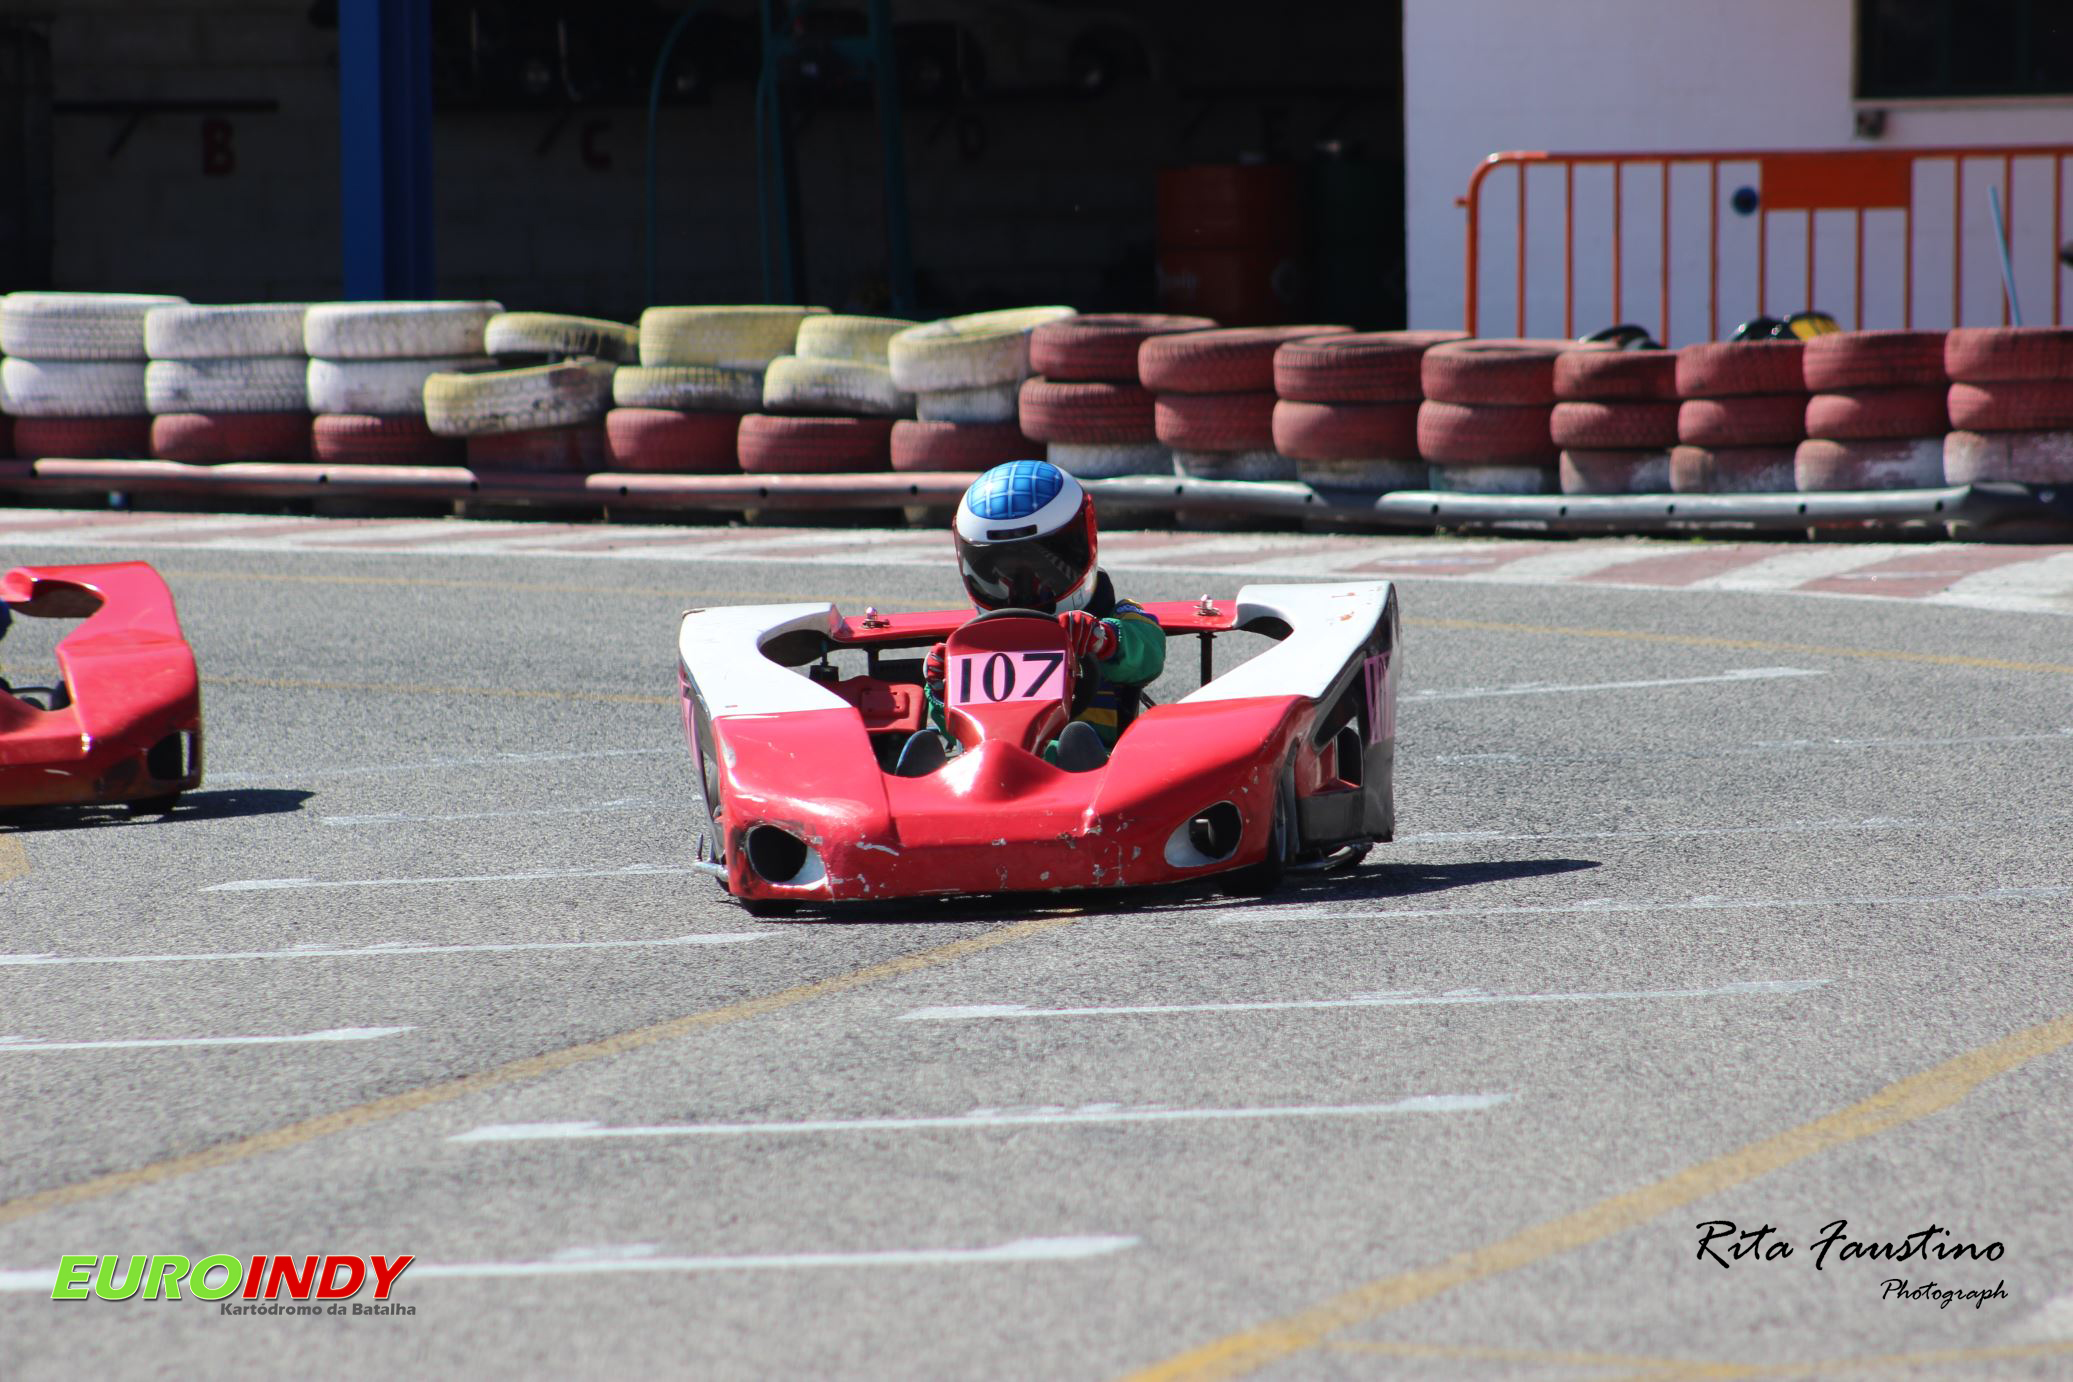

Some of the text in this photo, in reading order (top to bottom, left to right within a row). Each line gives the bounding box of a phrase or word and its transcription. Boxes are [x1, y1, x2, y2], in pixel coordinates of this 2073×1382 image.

[203, 119, 233, 176] B
[582, 120, 612, 169] C
[960, 652, 1064, 703] 107
